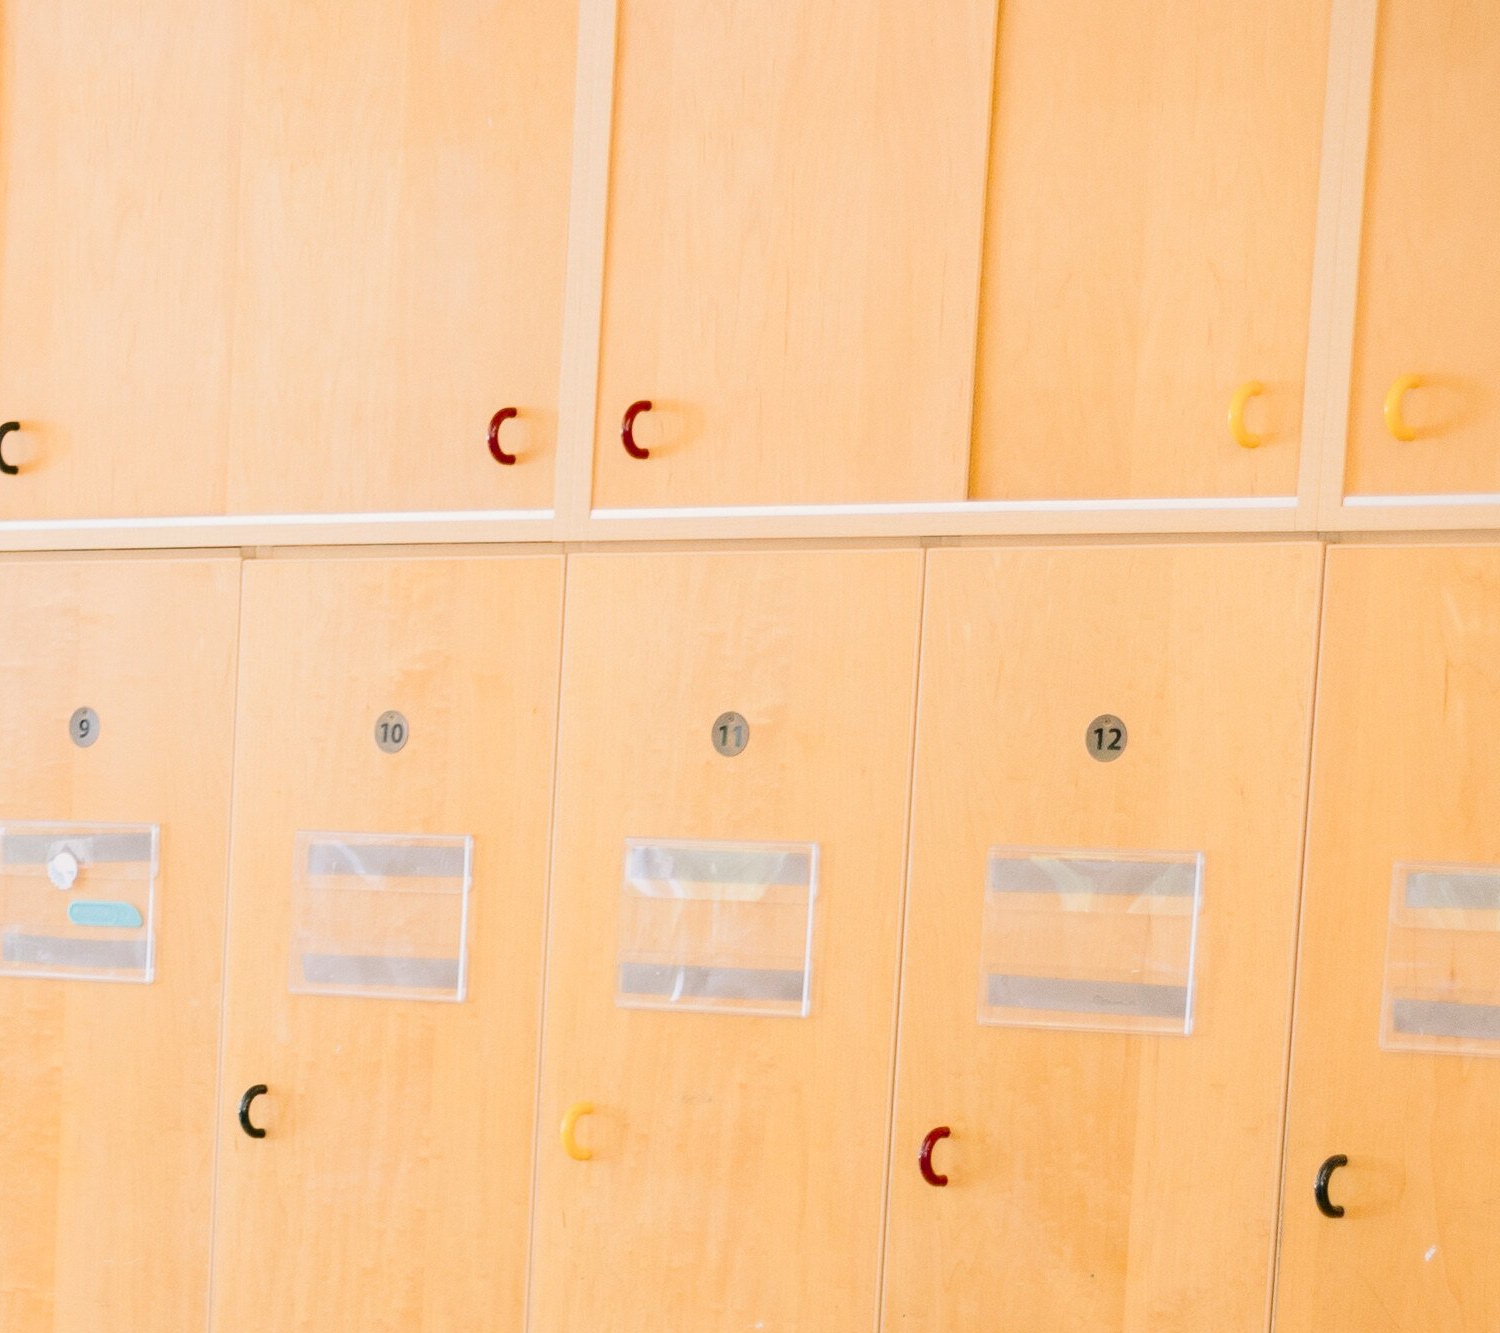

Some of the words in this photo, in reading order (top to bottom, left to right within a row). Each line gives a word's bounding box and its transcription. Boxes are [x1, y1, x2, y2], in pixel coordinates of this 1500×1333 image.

[78, 718, 91, 739] 9
[379, 722, 405, 744] 10
[719, 725, 744, 747] 11
[1094, 727, 1123, 752] 12
